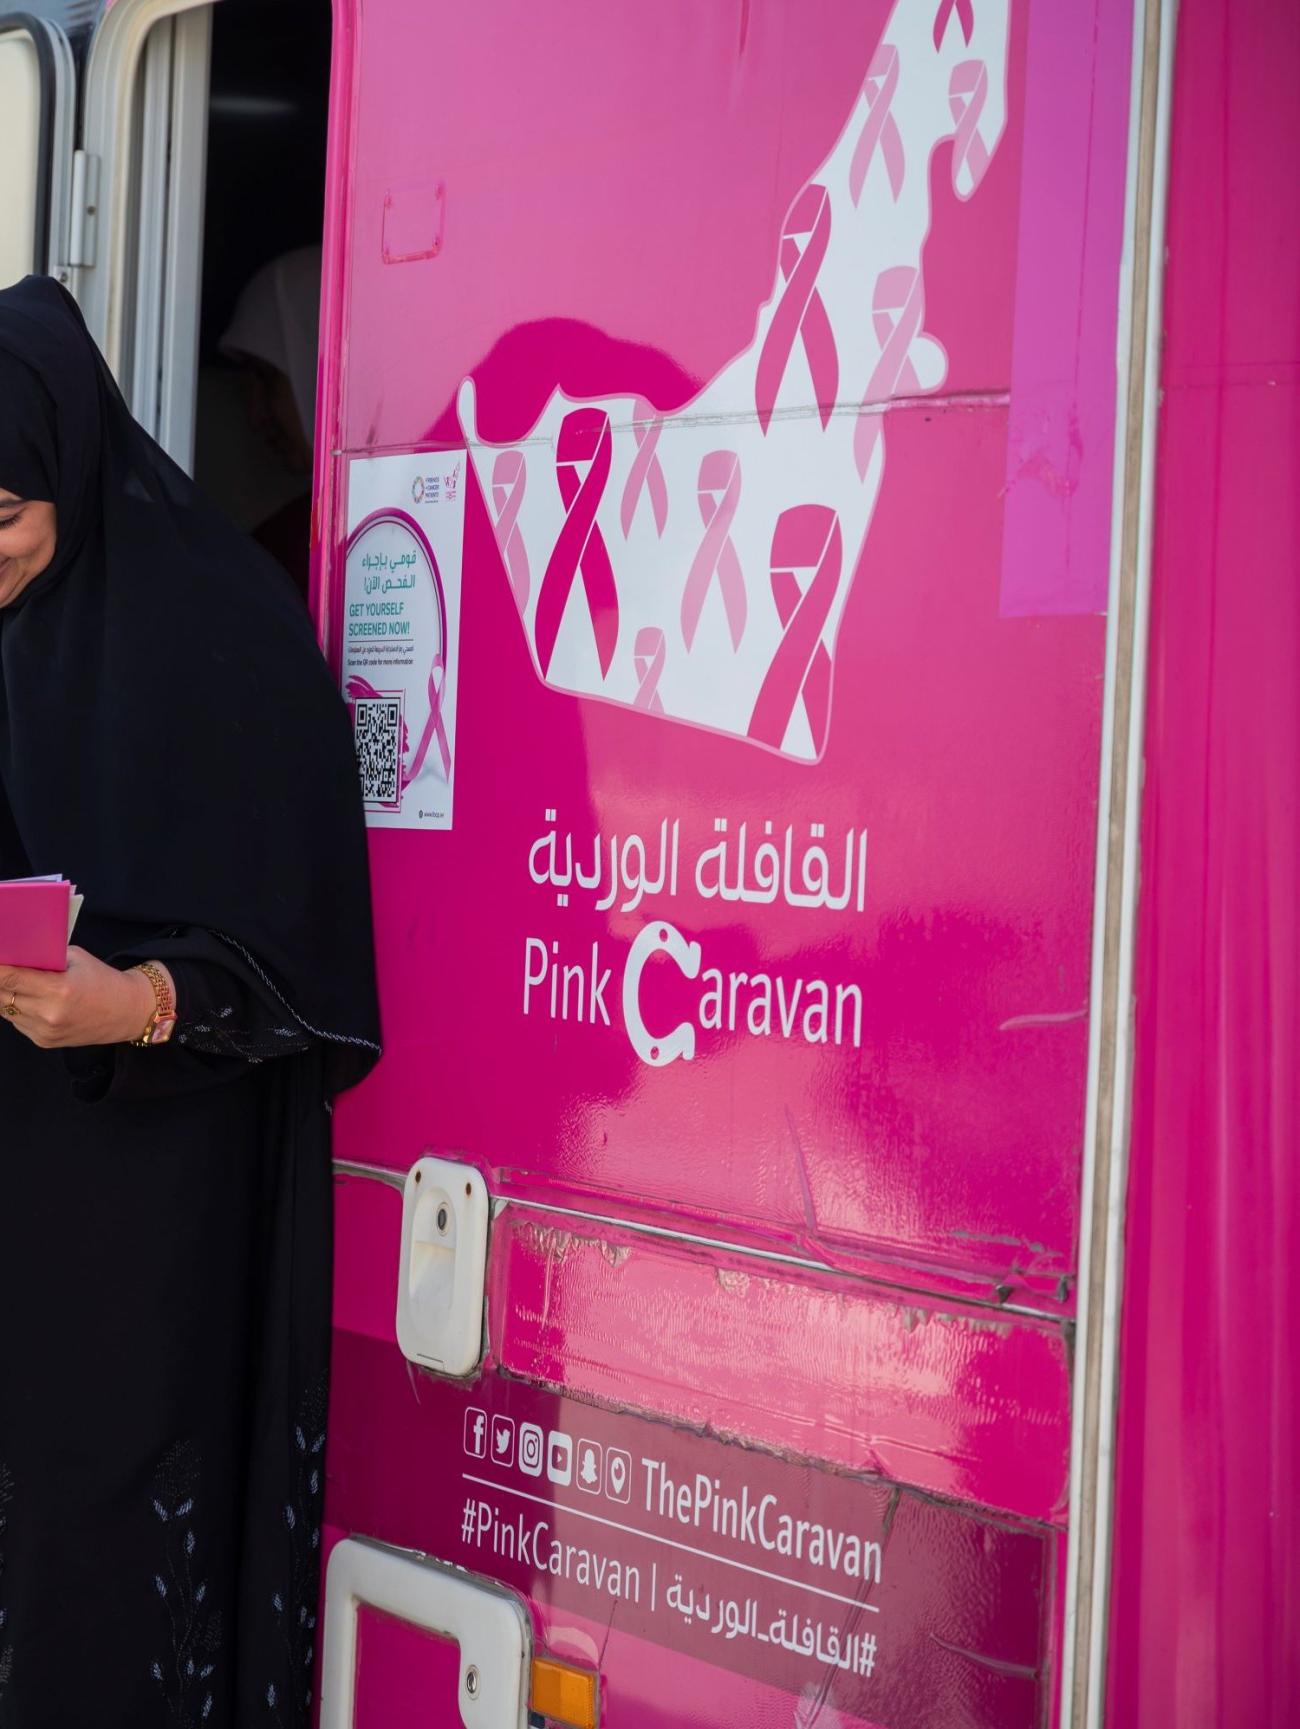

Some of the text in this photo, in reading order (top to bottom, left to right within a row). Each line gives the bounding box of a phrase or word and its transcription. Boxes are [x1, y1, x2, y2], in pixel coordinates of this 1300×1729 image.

[362, 550, 417, 573] قومي بإجراء
[381, 574, 416, 594] الفحص
[348, 621, 410, 636] SCREENED NOW!
[349, 602, 404, 617] GET YOURSELF
[528, 808, 868, 912] القافلة الوردية
[523, 920, 863, 1067] Pink Caravan
[461, 1498, 640, 1604] #PinkCaravan
[642, 1457, 882, 1584] ThePinkCaravan
